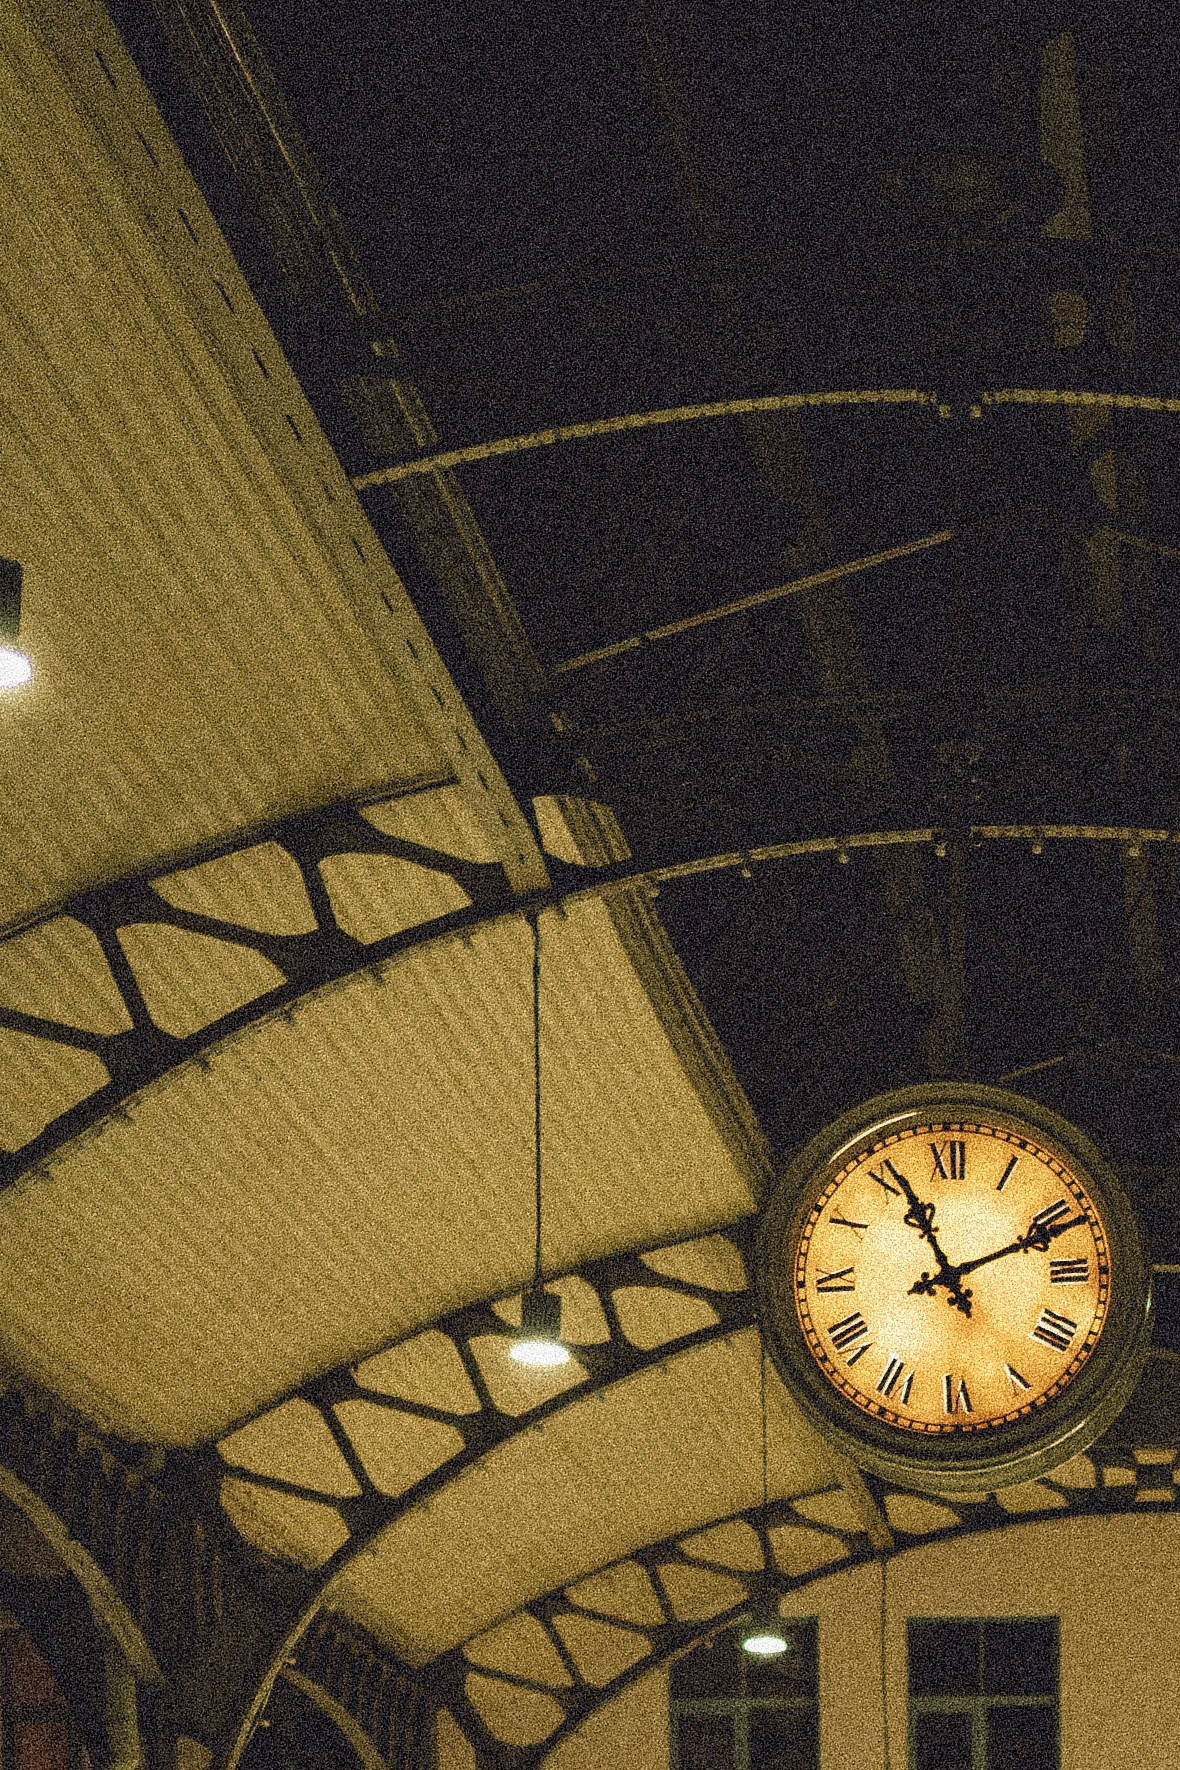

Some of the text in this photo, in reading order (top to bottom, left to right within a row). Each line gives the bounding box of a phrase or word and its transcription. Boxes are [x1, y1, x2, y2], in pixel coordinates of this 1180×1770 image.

[930, 1140, 966, 1182] XII
[996, 1154, 1018, 1191] I
[829, 1206, 870, 1242] X
[816, 1267, 855, 1293] IX
[1050, 1258, 1089, 1286] III
[828, 1311, 875, 1367] VIII
[1032, 1308, 1078, 1352] IIII
[876, 1357, 916, 1405] VII
[944, 1375, 973, 1414] VI
[1004, 1362, 1031, 1396] V
